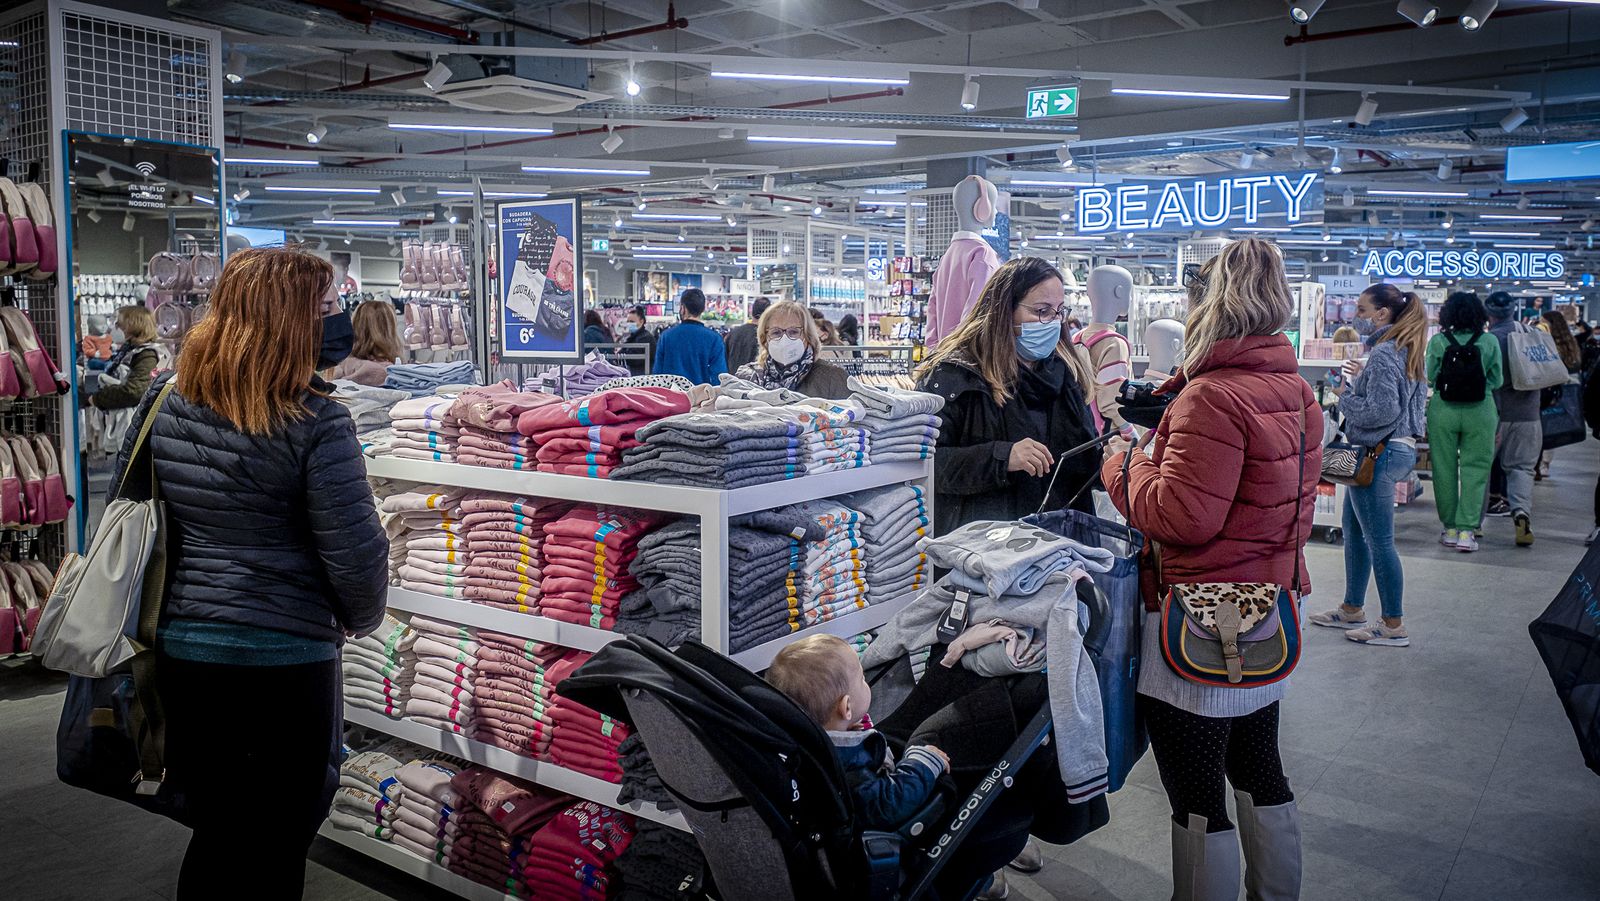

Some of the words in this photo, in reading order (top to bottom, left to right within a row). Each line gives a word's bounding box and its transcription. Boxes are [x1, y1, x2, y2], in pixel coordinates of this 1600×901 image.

[128, 200, 166, 209] NOSOTROS!
[130, 192, 163, 201] POMOS
[1078, 173, 1318, 232] BEAUTY
[1361, 250, 1565, 278] ACCESSORIES
[1333, 279, 1354, 288] PIEL
[519, 327, 535, 344] 6€
[926, 833, 952, 859] be
[950, 793, 983, 831] cool
[980, 760, 1010, 793] slide
